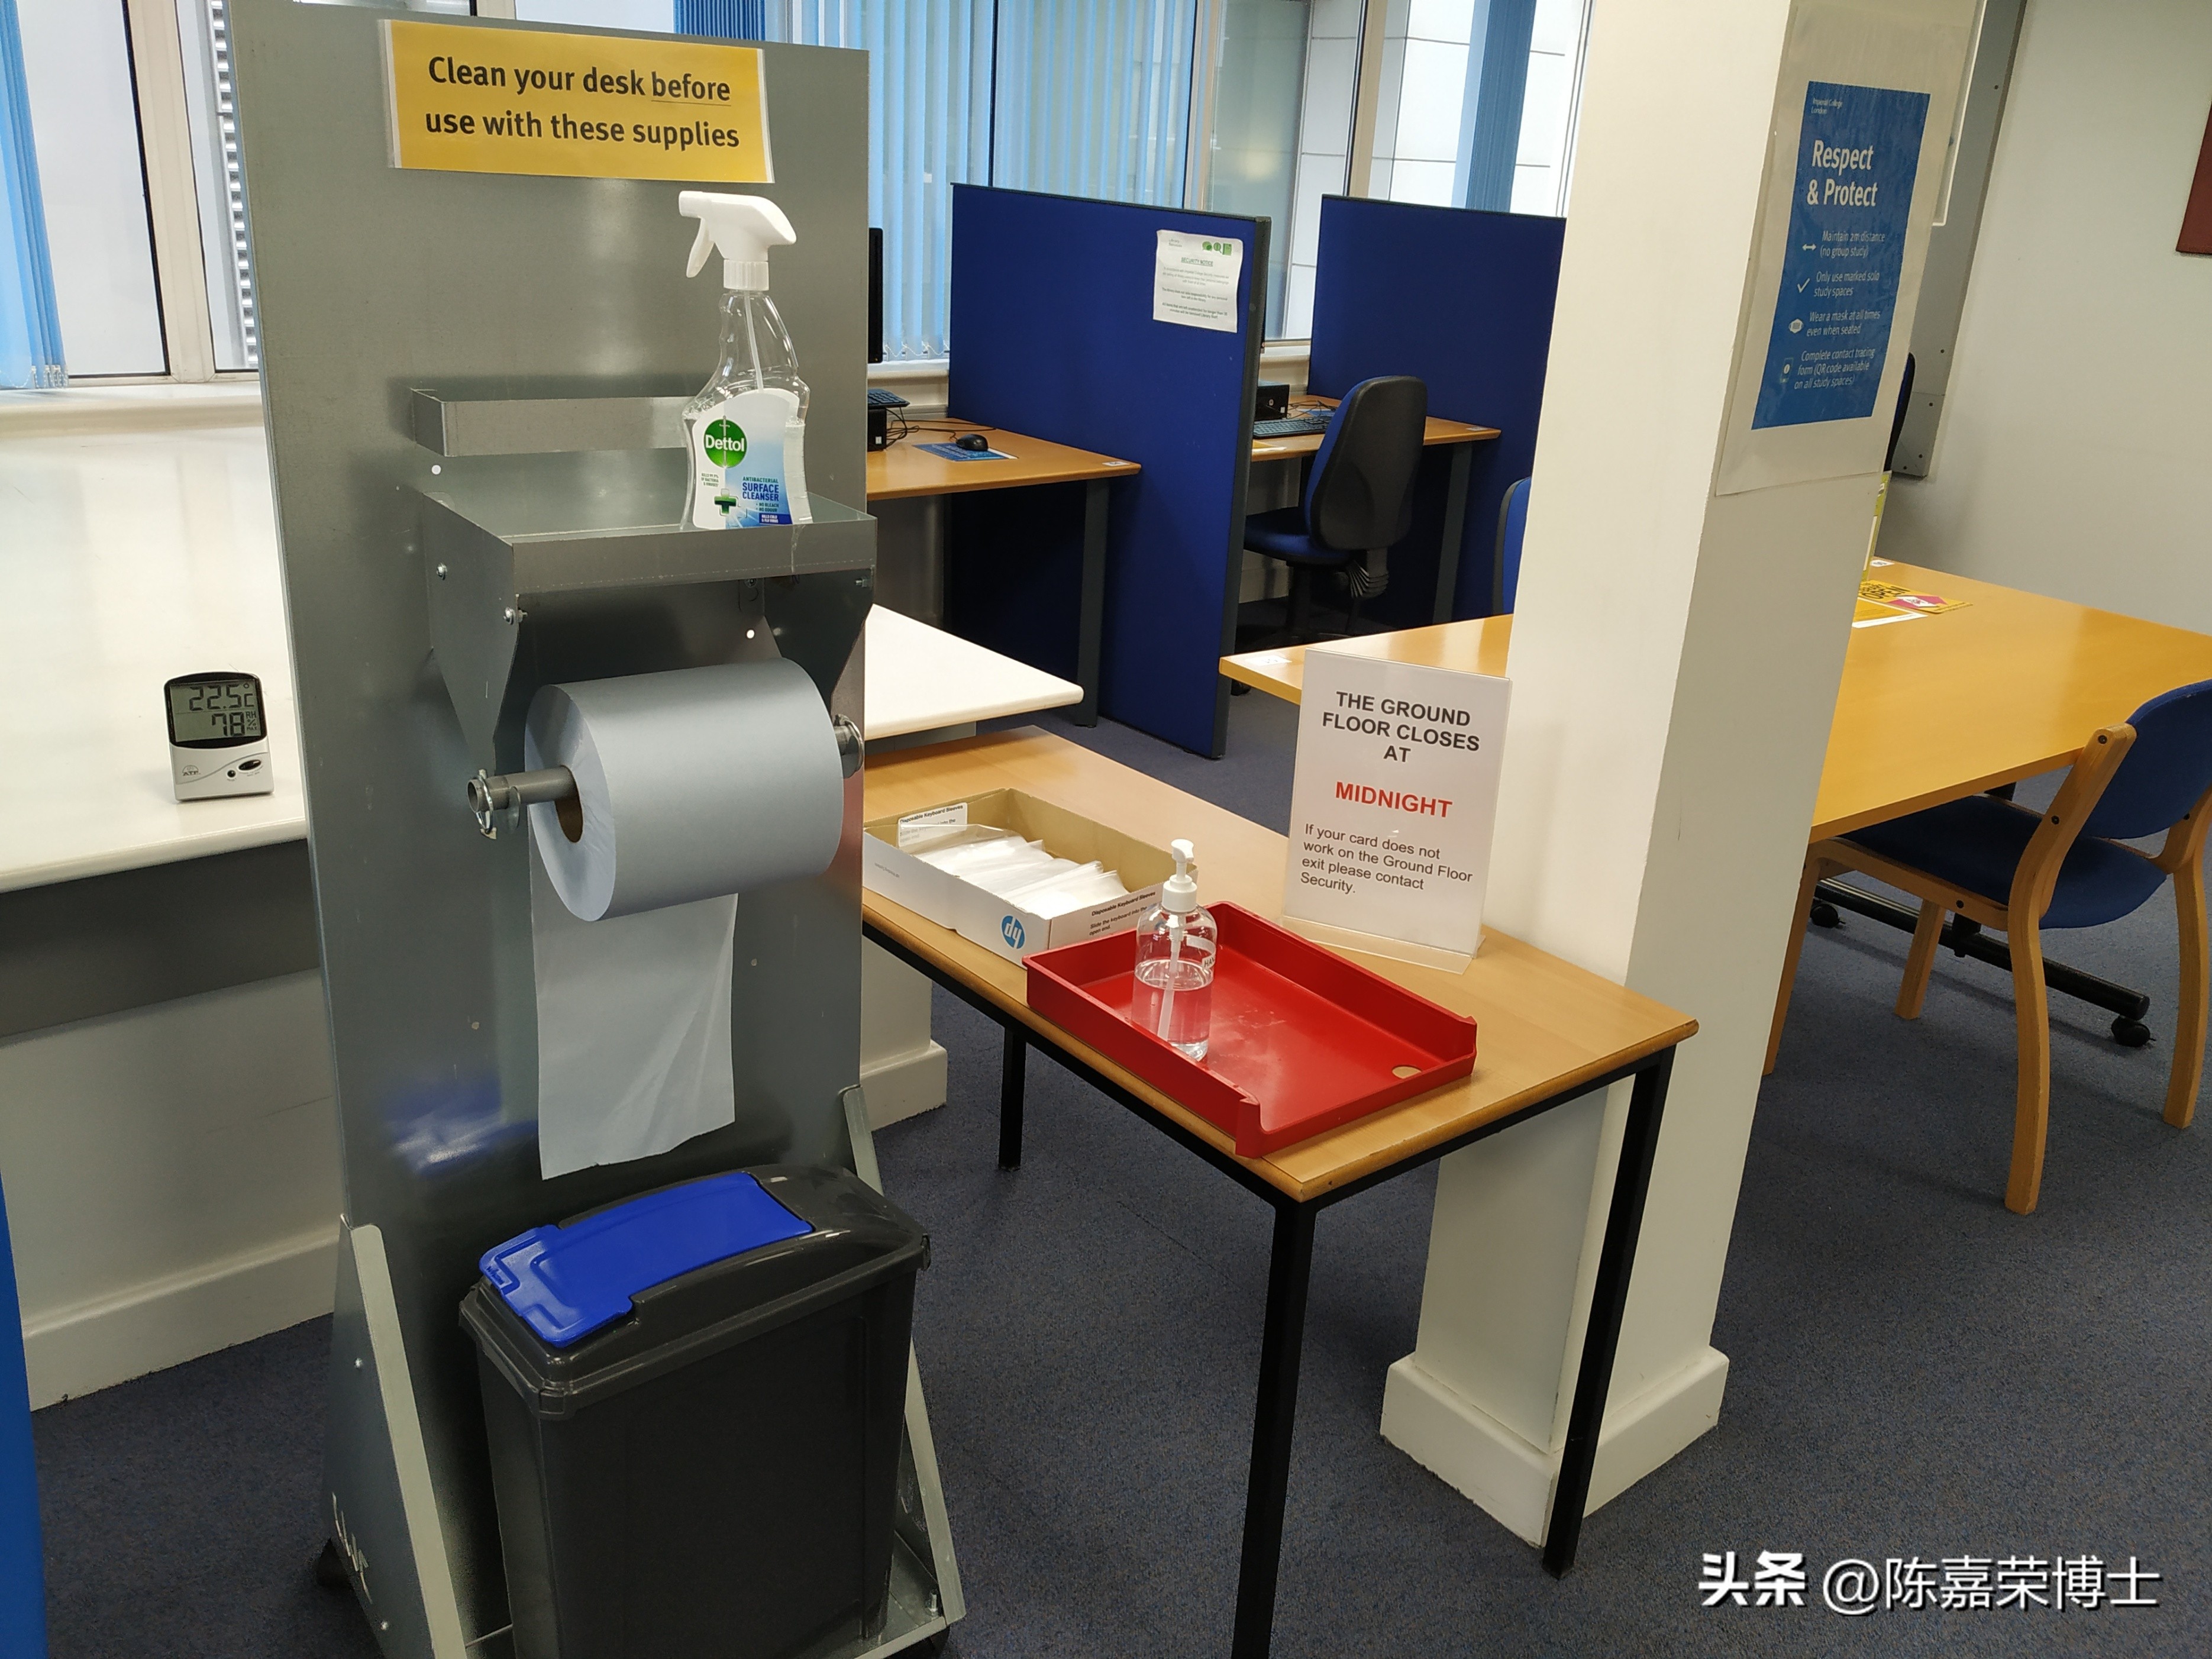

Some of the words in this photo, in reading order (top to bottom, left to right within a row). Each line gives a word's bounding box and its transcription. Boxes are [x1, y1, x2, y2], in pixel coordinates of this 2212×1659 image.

[428, 56, 506, 88] Clean
[514, 62, 574, 97] your
[583, 67, 646, 96] desk
[651, 71, 731, 101] before
[1811, 106, 1827, 114] London
[1829, 99, 1843, 109] College
[425, 112, 474, 134] use
[483, 110, 542, 137] with
[551, 114, 625, 142] these
[632, 121, 740, 151] supplies
[1812, 140, 1874, 176] Respect
[1807, 179, 1819, 205] &
[1823, 178, 1878, 206] Protect
[1822, 230, 1849, 241] Maintain
[1850, 232, 1860, 241] 2m
[1861, 231, 1885, 241] distance
[1820, 245, 1831, 258] (no
[1831, 247, 1849, 259] group
[1851, 245, 1869, 259] study)
[1816, 271, 1831, 284] Only
[1832, 273, 1843, 282] use
[1844, 270, 1867, 281] marked
[1867, 270, 1880, 281] solo
[1814, 286, 1832, 298] study
[1832, 288, 1853, 298] spaces
[1809, 312, 1826, 322] Wear
[1831, 309, 1848, 321] mask
[1849, 311, 1856, 320] at
[1864, 309, 1881, 319] times
[1807, 328, 1822, 336] even
[1823, 325, 1840, 335] when
[1840, 324, 1862, 334] seated
[1801, 349, 1831, 362] Complete
[1832, 348, 1854, 359] contact
[1855, 347, 1876, 359] tracing
[1797, 364, 1813, 375] form
[1813, 363, 1826, 376] (QR
[1826, 363, 1842, 373] code
[1842, 360, 1870, 372] available
[1794, 381, 1803, 389] on
[1804, 377, 1813, 388] all
[1813, 376, 1830, 389] study
[1830, 374, 1855, 388] spaces)
[705, 434, 745, 451] Dettol
[742, 482, 779, 493] SURFACE
[742, 491, 779, 501] CLEANSER
[1336, 691, 1375, 712] THE
[1381, 699, 1471, 727] GROUND
[212, 712, 246, 737] 78
[1323, 712, 1391, 737] FLOOR
[1396, 724, 1480, 751] CLOSES
[1383, 745, 1411, 762] AT
[1335, 781, 1453, 818] MIDNIGHT
[900, 814, 923, 823] Disposable
[924, 808, 945, 818] Keyboard
[1304, 823, 1315, 835] If
[1316, 827, 1346, 841] your
[1349, 834, 1378, 848] card
[1382, 839, 1415, 854] does
[1419, 847, 1441, 860] not
[1303, 841, 1334, 856] work
[1338, 848, 1354, 859] on
[1359, 850, 1379, 864] the
[1383, 855, 1433, 874] Ground
[1438, 865, 1473, 882] Floor
[1302, 858, 1325, 870] exit
[1328, 863, 1371, 879] please
[1375, 872, 1424, 889] contact
[1301, 872, 1356, 895] Security.
[1092, 905, 1116, 916] Disposable
[1118, 896, 1139, 908] Keyboard
[1139, 892, 1155, 900] Sleeves
[1110, 912, 1131, 922] keyboard
[1003, 915, 1024, 949] hp
